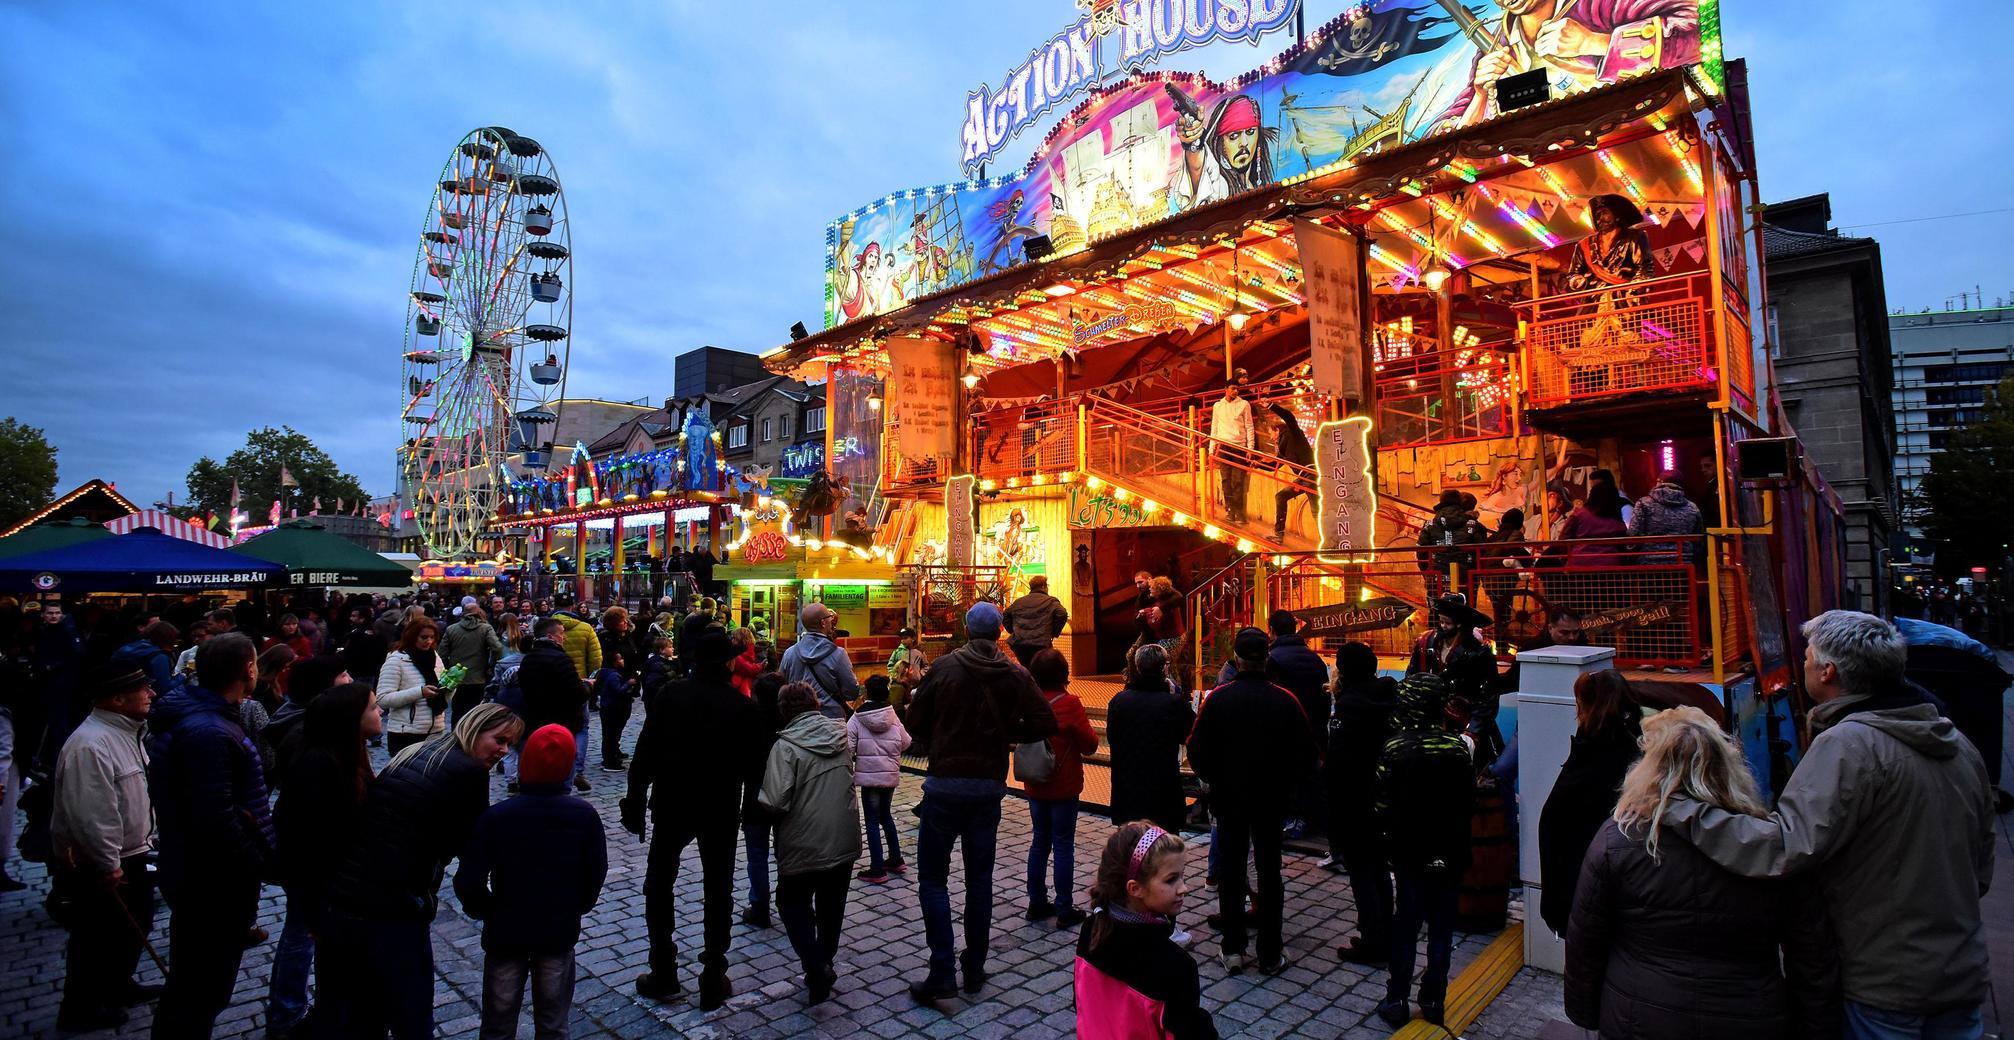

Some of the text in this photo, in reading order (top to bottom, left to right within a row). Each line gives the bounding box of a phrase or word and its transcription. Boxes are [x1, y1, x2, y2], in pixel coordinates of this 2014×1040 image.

[962, 22, 1095, 163] ACTION
[784, 436, 865, 471] TWISER
[1332, 429, 1352, 551] EINGANG
[155, 571, 267, 585] LANDWEHR-BRÄU
[309, 572, 339, 584] BIERE
[1312, 605, 1397, 630] EINGANG
